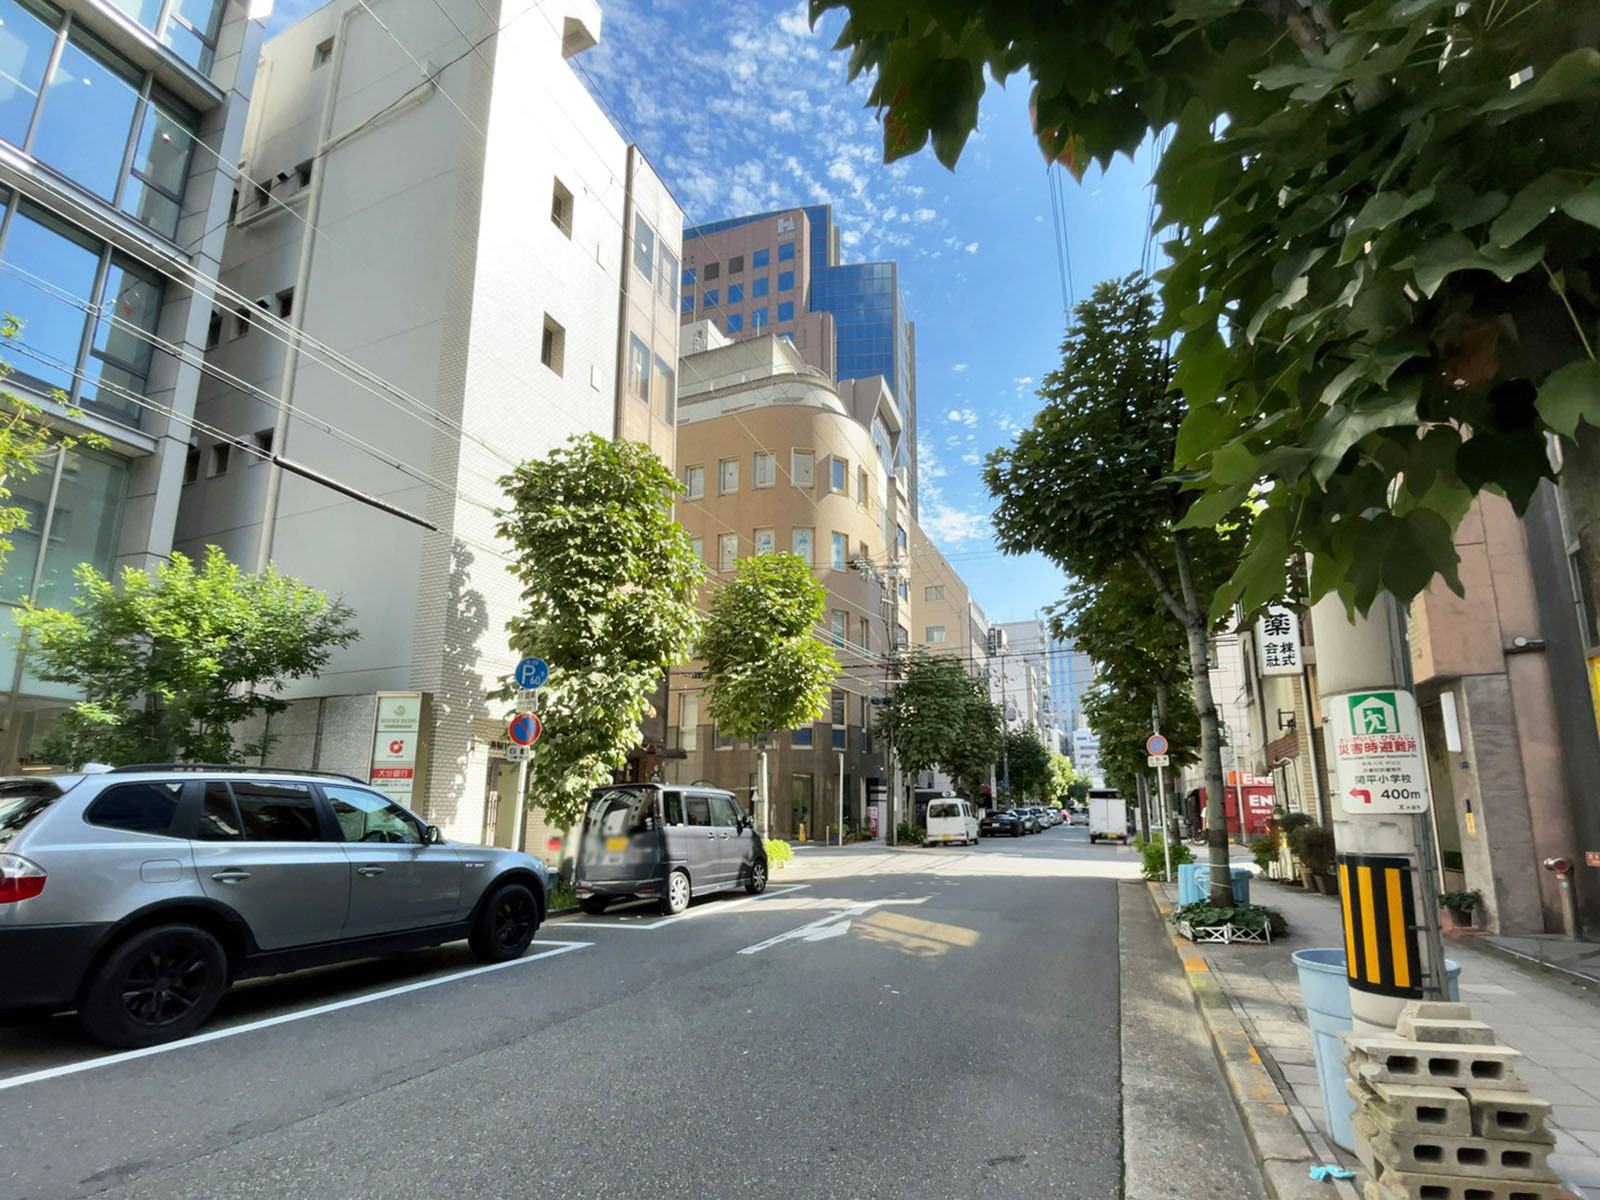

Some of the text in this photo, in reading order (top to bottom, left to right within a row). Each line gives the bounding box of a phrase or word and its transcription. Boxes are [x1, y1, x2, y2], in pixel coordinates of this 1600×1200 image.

[1264, 601, 1291, 636] 薬
[521, 664, 536, 684] P
[530, 676, 540, 684] 60
[1338, 740, 1417, 755] 災害時避難所
[378, 769, 409, 778] 大分銀行
[1381, 788, 1421, 800] 400m
[1249, 795, 1276, 807] EN
